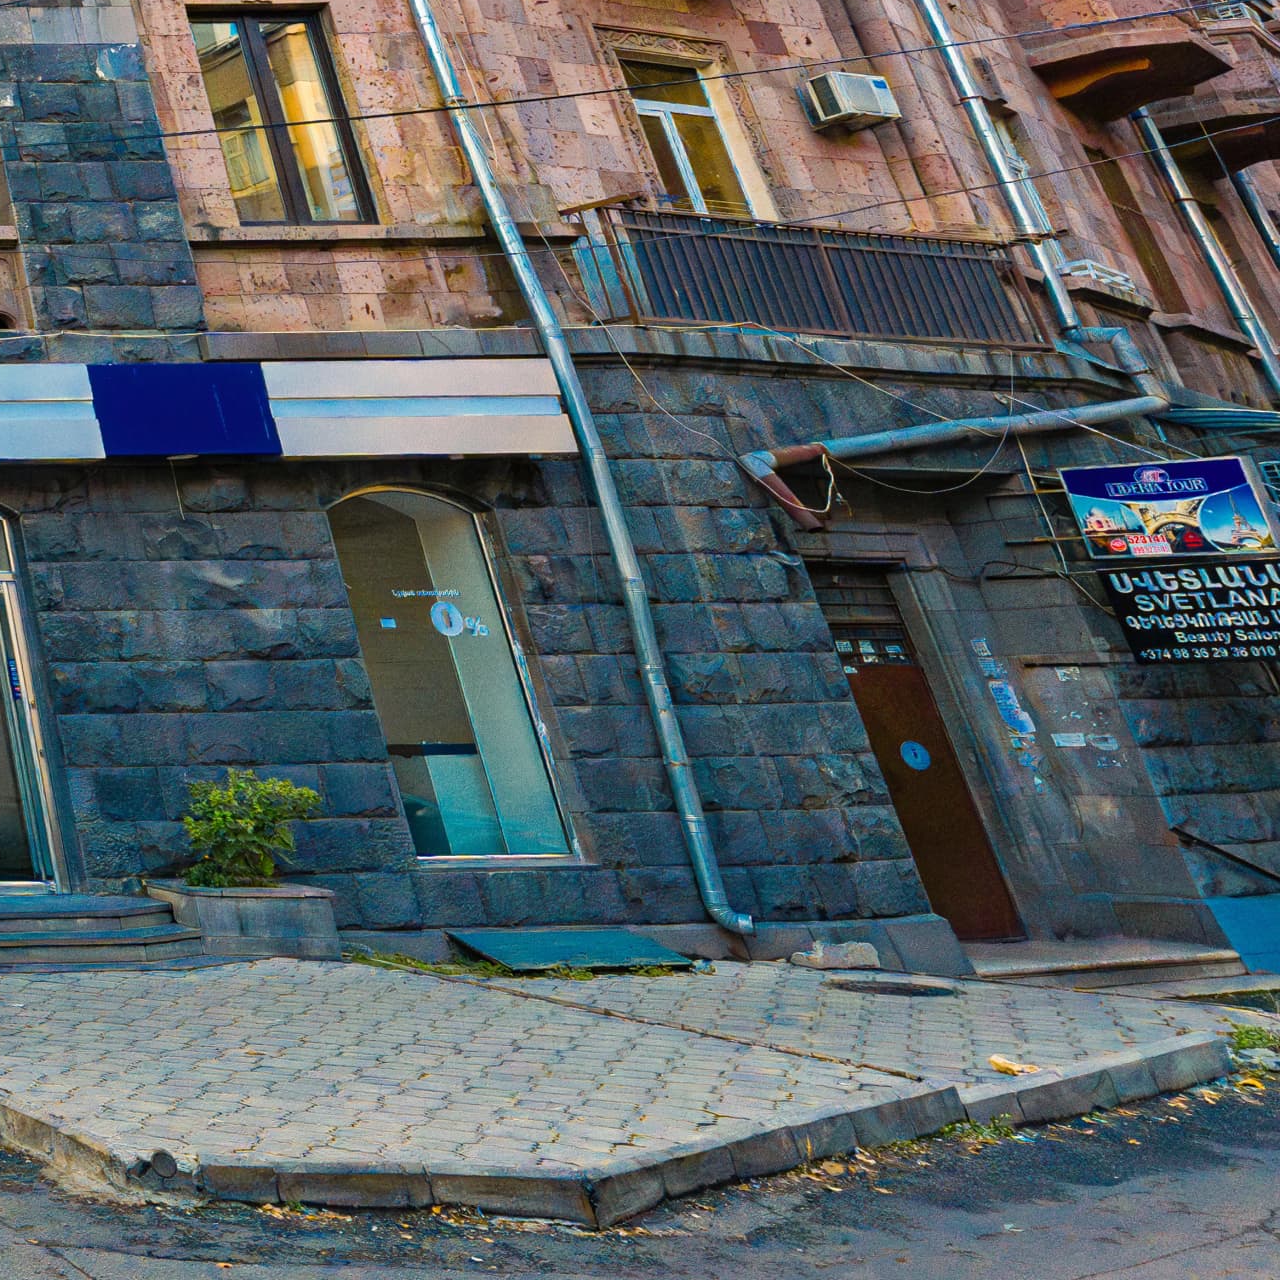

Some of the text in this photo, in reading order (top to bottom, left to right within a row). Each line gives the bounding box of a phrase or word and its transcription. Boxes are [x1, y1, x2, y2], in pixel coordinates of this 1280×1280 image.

[1166, 478, 1205, 492] TOUR
[1174, 630, 1231, 644] Beauty
[1140, 645, 1276, 659] +374 98 36 29 36 010
